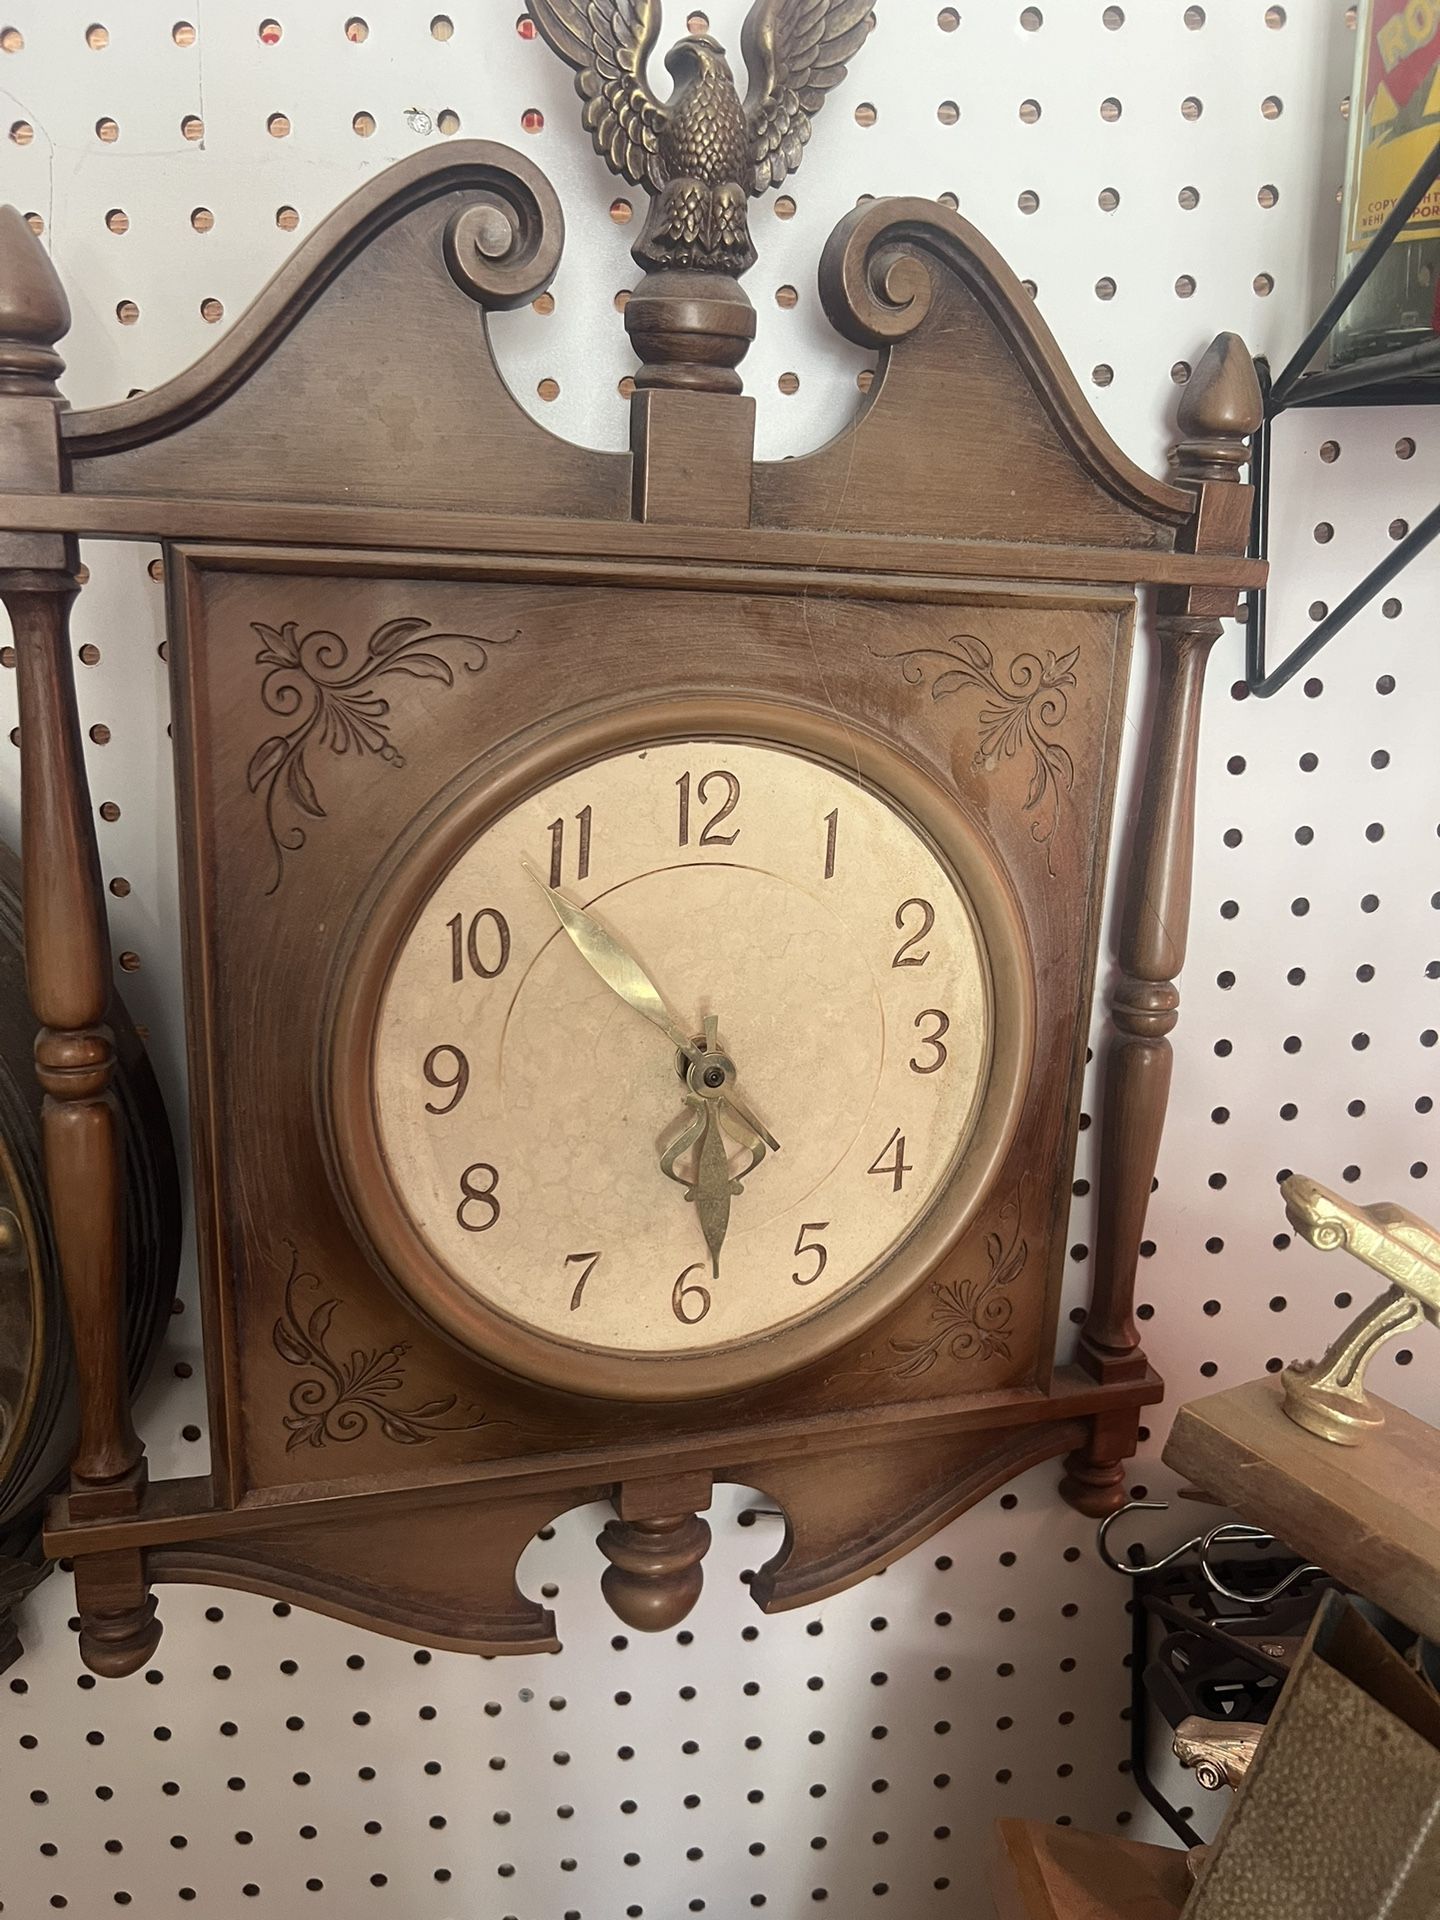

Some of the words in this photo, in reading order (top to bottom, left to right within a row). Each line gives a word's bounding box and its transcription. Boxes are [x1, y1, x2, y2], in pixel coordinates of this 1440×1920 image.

[1367, 192, 1440, 213] COPYHT
[675, 770, 740, 847] 12
[547, 805, 592, 888] 11
[824, 808, 838, 879] 1
[446, 908, 511, 983] 10
[892, 898, 935, 968] 2
[909, 1009, 950, 1074] 3
[422, 1044, 470, 1115] 9
[867, 1127, 914, 1192] 4
[456, 1163, 501, 1232] 8
[564, 1252, 602, 1311] 7
[792, 1222, 830, 1286] 5
[672, 1263, 712, 1324] 6
